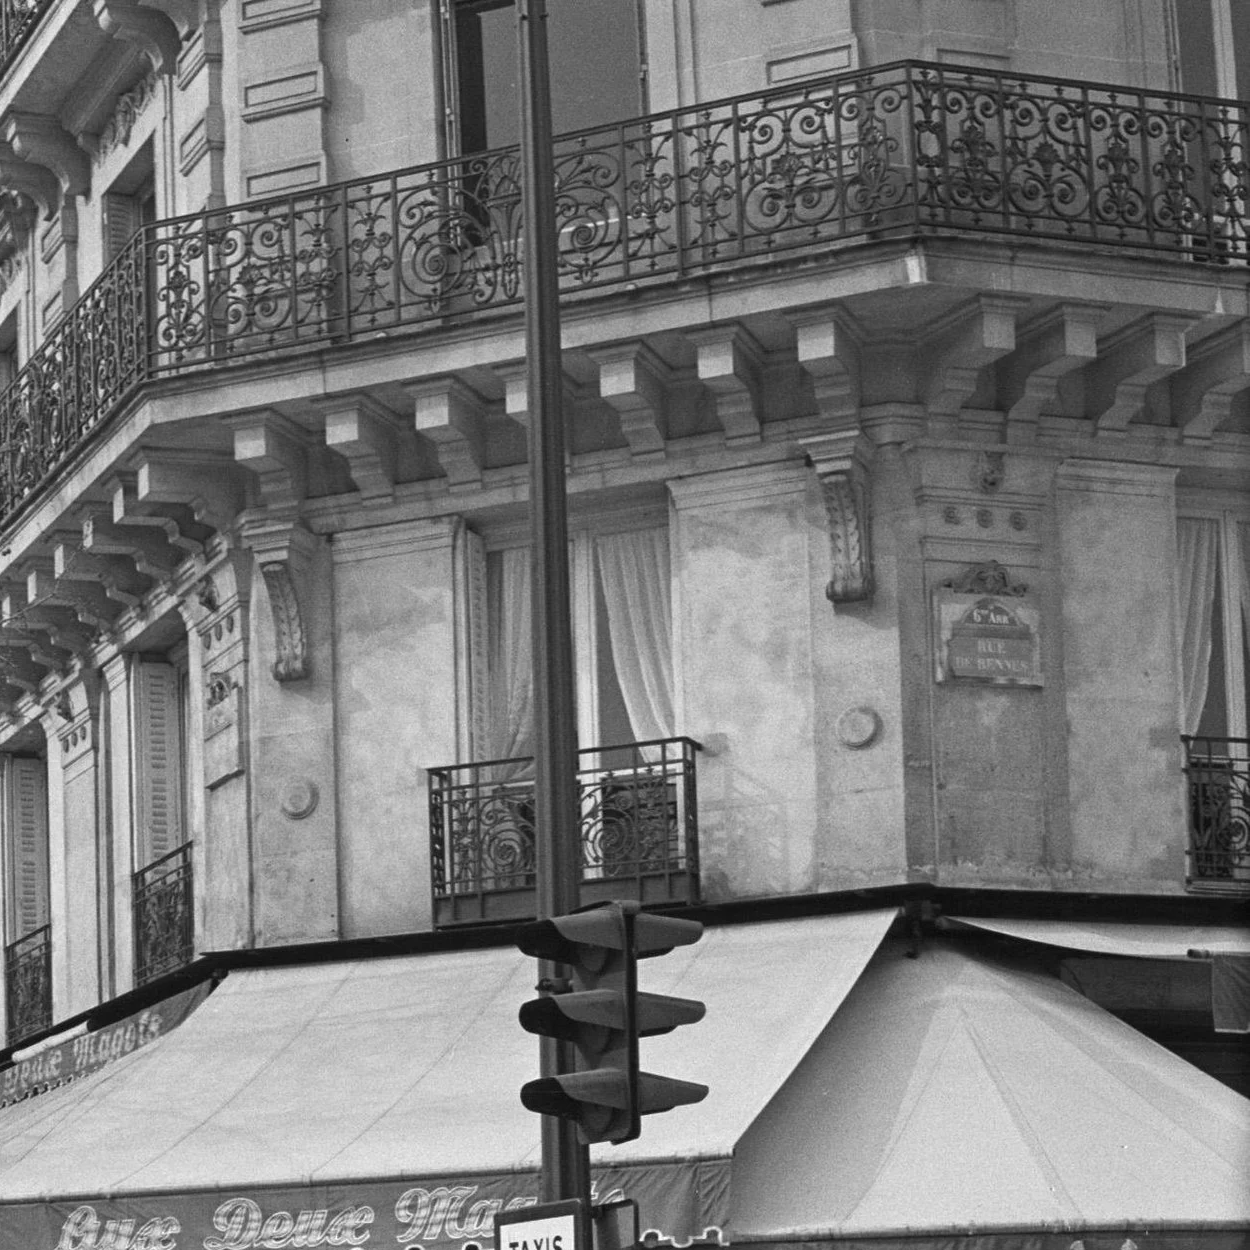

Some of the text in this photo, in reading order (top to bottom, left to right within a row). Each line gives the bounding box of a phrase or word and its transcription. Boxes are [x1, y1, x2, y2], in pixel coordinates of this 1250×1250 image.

[977, 638, 1007, 655] RUE
[976, 656, 1030, 673] RENNES
[73, 1010, 163, 1072] Magots
